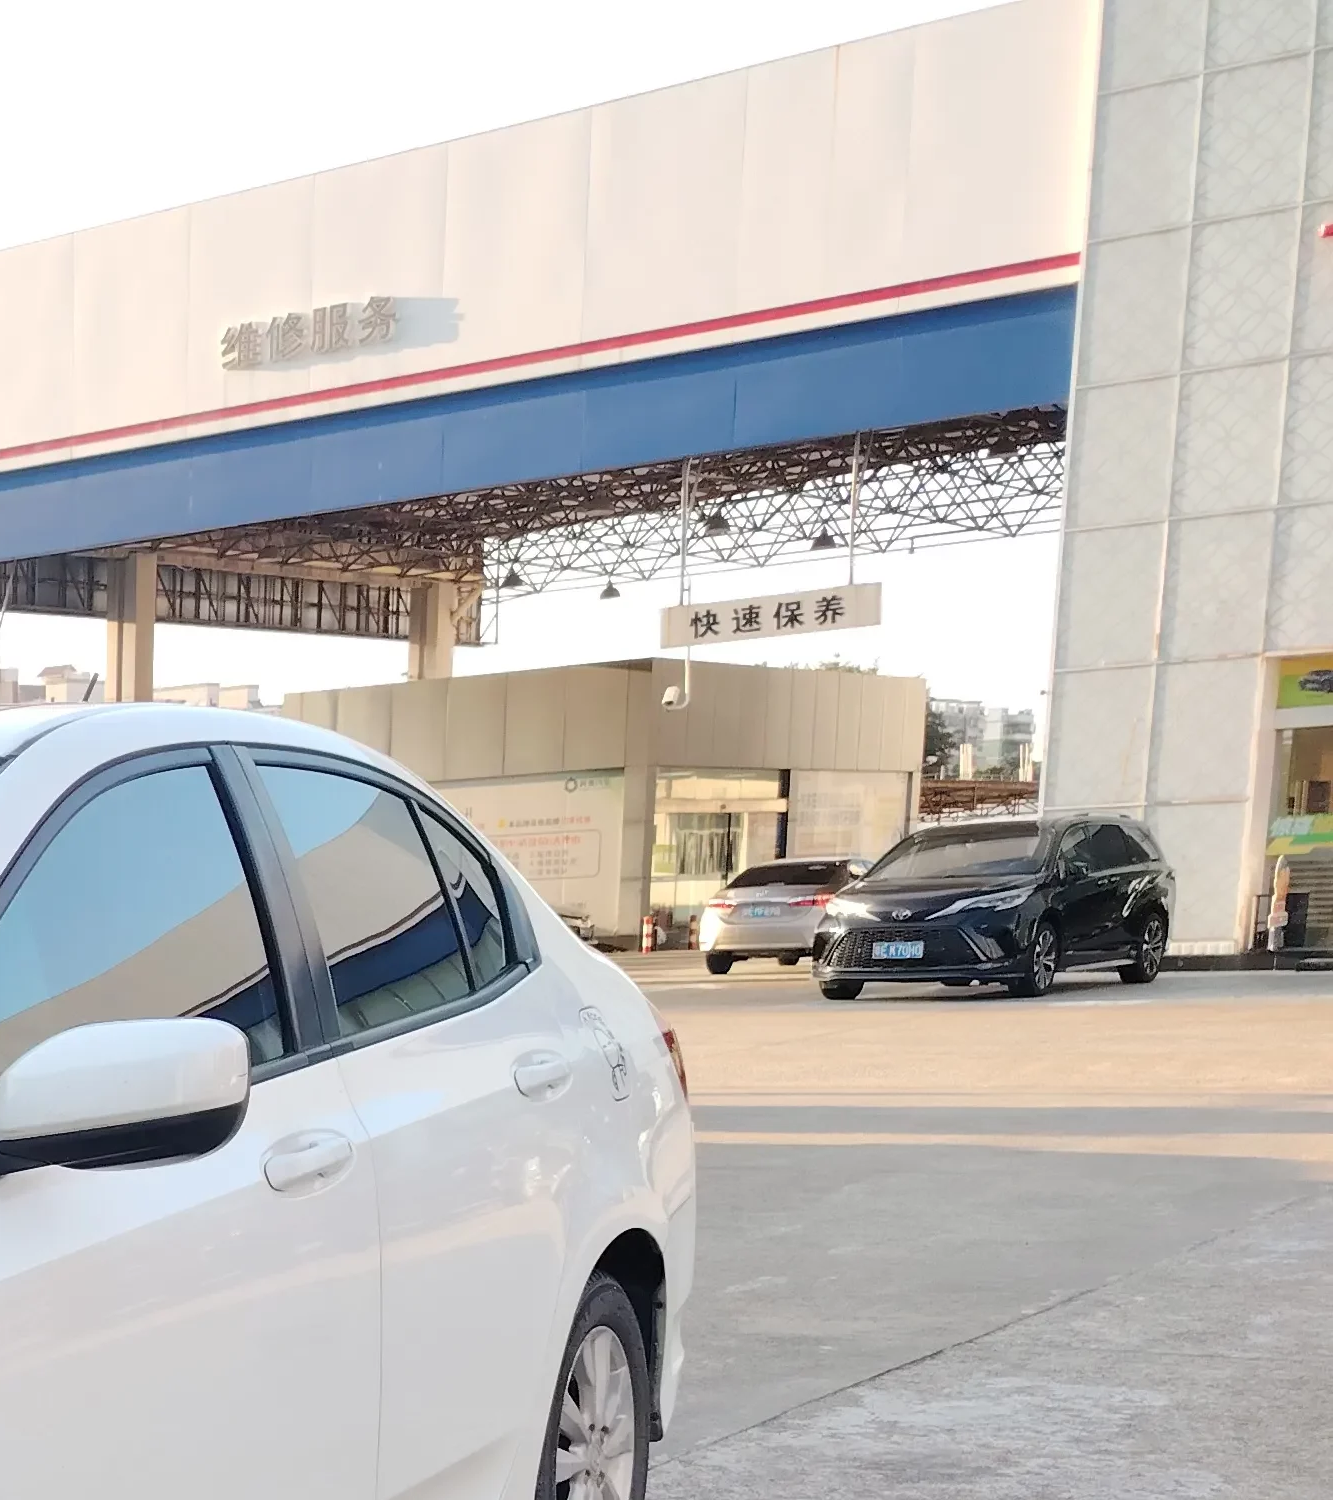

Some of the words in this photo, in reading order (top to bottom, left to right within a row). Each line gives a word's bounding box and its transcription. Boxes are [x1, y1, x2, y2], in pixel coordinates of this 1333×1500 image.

[220, 296, 398, 370] 维修服务
[689, 594, 846, 639] 快速保养
